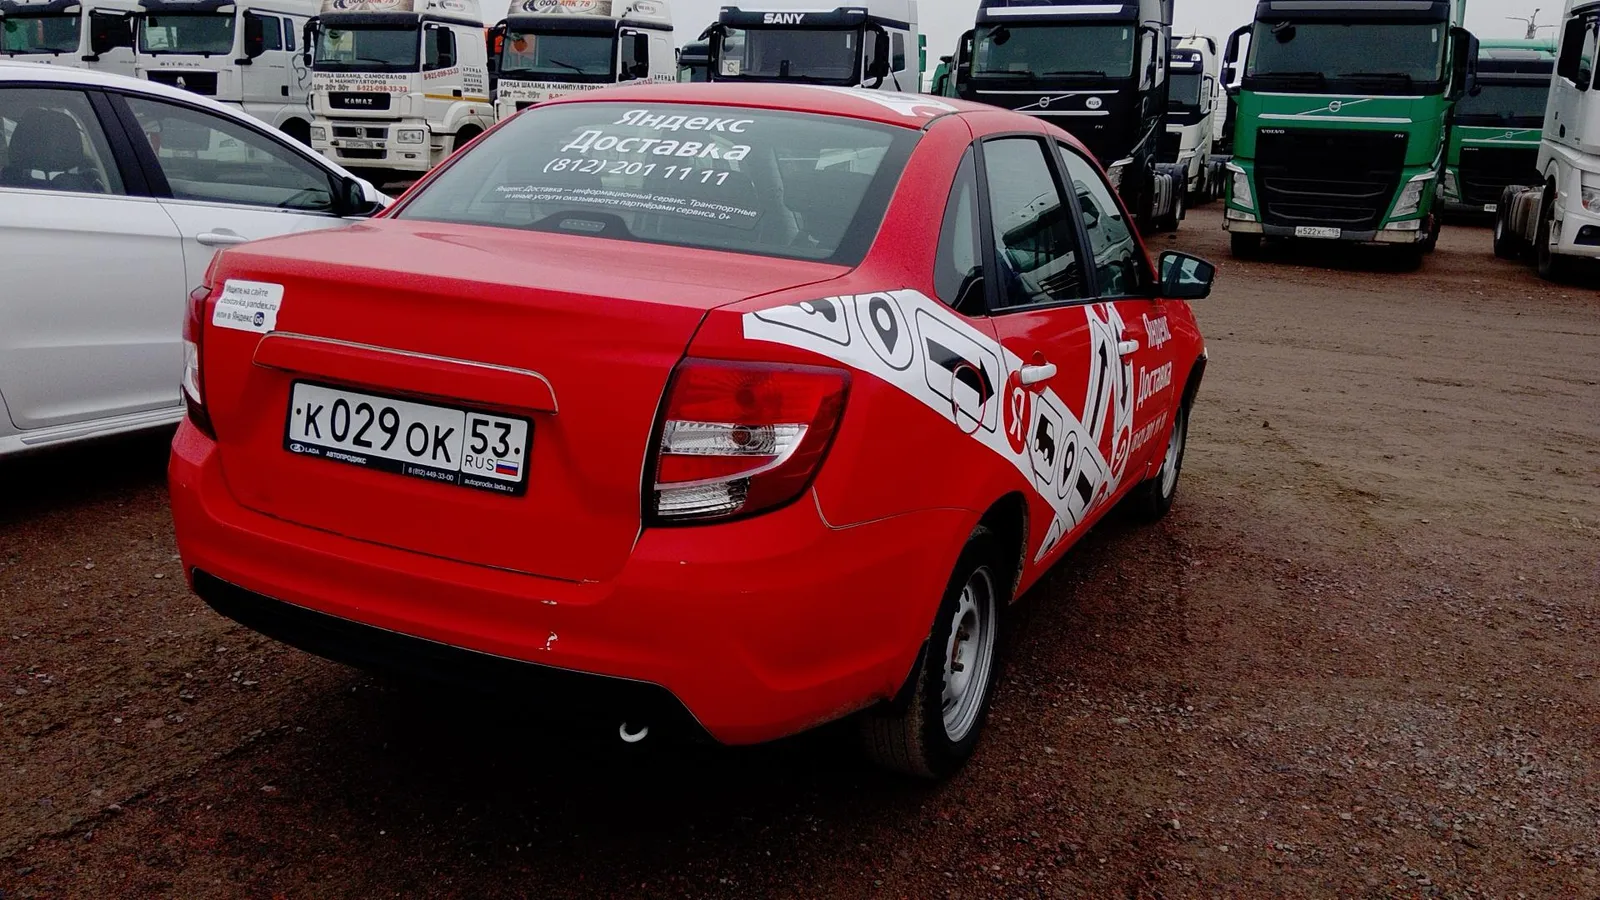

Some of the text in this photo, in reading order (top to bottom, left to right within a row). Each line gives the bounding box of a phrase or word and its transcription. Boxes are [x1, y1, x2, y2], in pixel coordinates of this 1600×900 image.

[763, 13, 805, 24] SANY
[612, 109, 754, 133] Яндекс
[560, 130, 752, 161] Доставка
[542, 158, 730, 186] (812) 201 11 11
[562, 195, 620, 205] оказываются
[676, 207, 717, 219] сервиса.
[718, 212, 731, 220] 0+
[572, 188, 653, 200] информационный
[690, 199, 757, 217] Транспортные
[1010, 387, 1025, 442] Я
[470, 418, 512, 458] 53
[304, 447, 320, 455] LADA
[325, 450, 367, 465] АВТОПРОДИКС
[464, 455, 494, 471] RUS
[426, 470, 454, 481] 449-33-00
[464, 478, 514, 492] autoprodix.lada.ru
